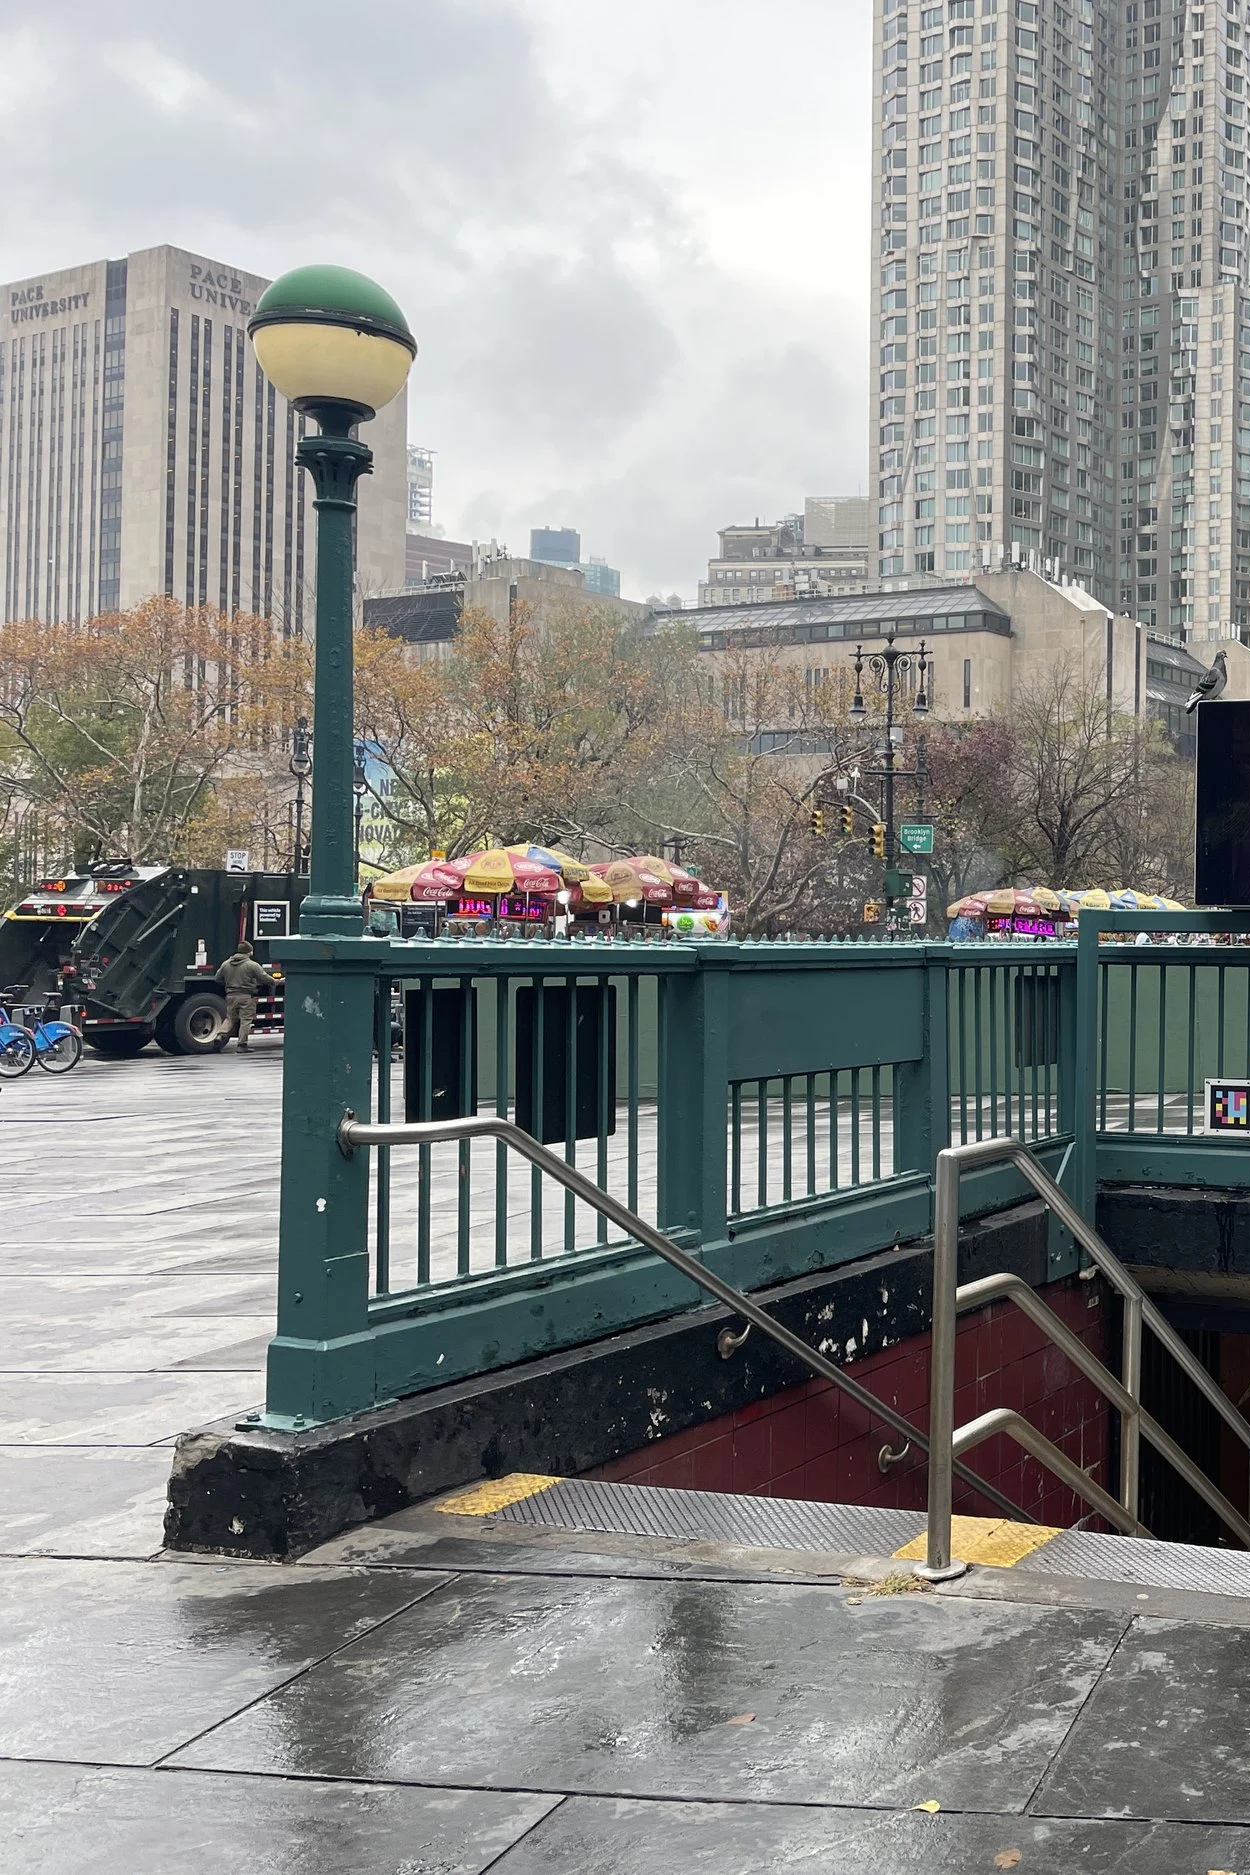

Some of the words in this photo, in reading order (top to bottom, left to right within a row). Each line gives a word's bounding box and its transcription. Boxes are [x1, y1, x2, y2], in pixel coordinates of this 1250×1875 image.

[190, 264, 243, 295] PACE
[11, 285, 44, 307] PACE
[189, 282, 257, 317] UNIVE
[10, 291, 91, 324] UNIVERSITY
[903, 828, 931, 837] Brooklyn
[907, 835, 927, 843] Bridge
[230, 851, 246, 860] STOP
